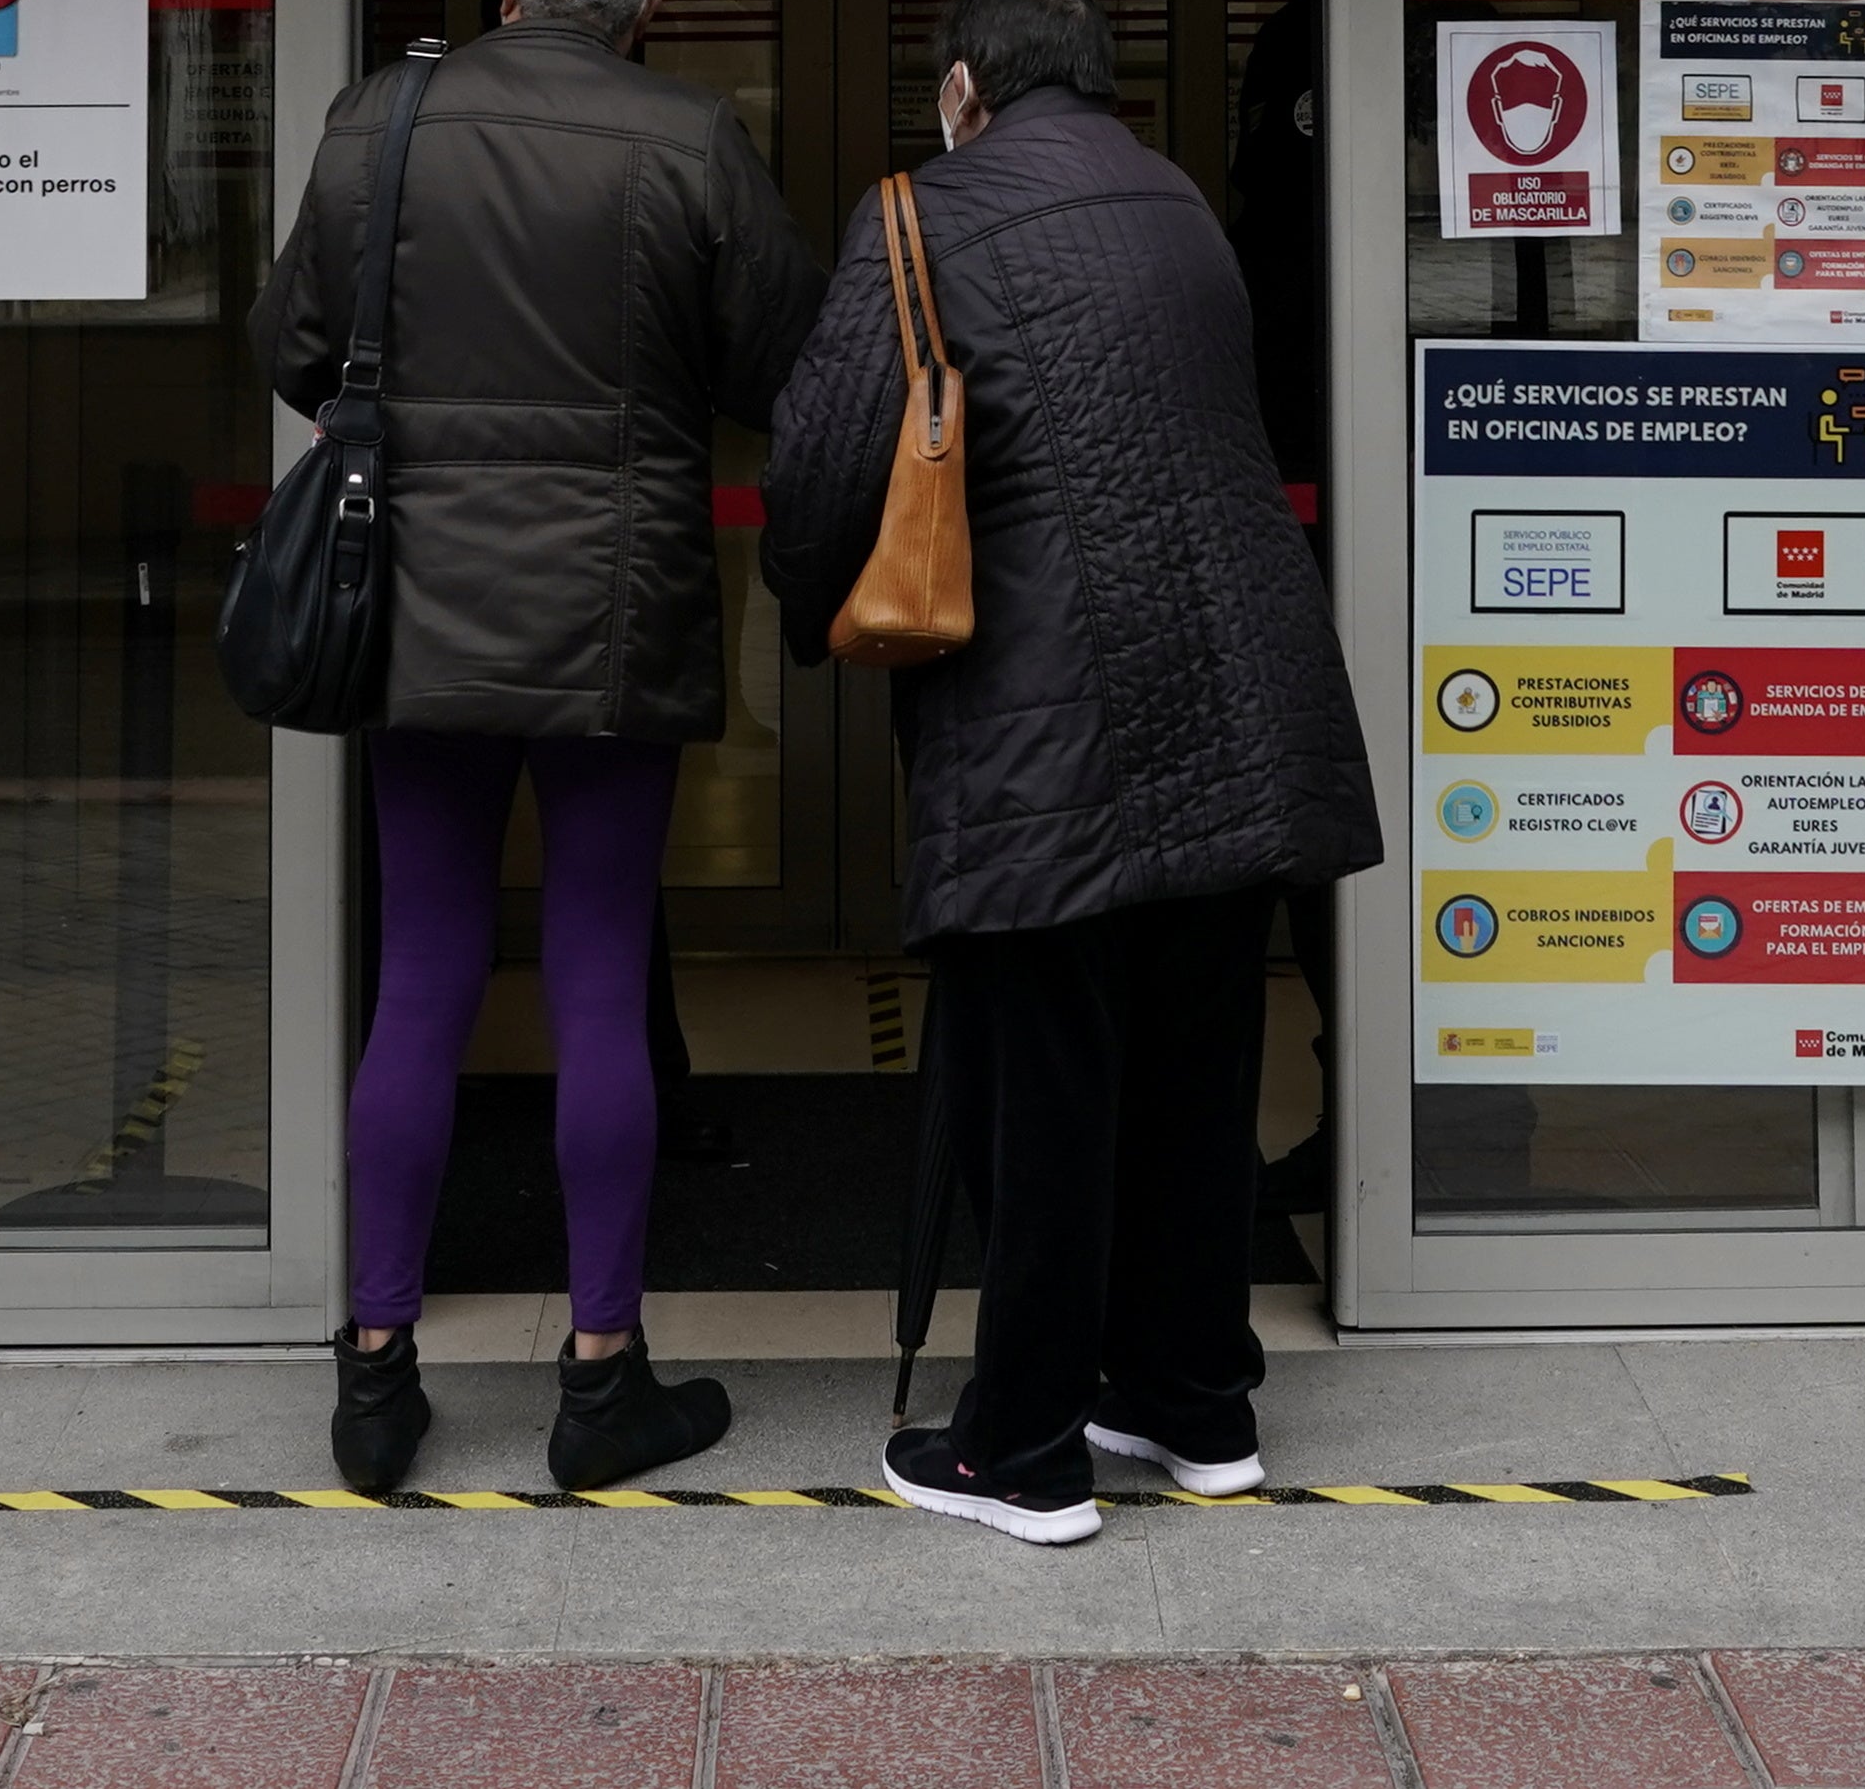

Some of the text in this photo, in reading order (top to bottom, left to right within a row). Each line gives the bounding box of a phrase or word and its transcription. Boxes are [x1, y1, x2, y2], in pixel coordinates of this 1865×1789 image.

[1670, 15, 1825, 29] ¿QUÉ SERVICIOS SE PRESTAN
[1671, 33, 1808, 44] EN OFICINAS DE EMPLEO?
[1695, 83, 1740, 100] SEPE
[19, 151, 38, 168] el
[42, 179, 115, 197] perros
[1518, 177, 1541, 190] USO
[1493, 192, 1566, 205] OBLIGATORIO
[1472, 207, 1587, 221] DE MASCARILLA
[1444, 379, 1786, 409] ¿QUÉ SERVICIOS SE PRESTAN
[1449, 420, 1747, 441] EN OFICINAS DE EMPLEO?
[1503, 531, 1591, 540] SERVICIO PÚBLICO
[1503, 542, 1590, 551] DE EMPLEO ESTATAL
[1504, 568, 1590, 596] SEPE
[1518, 678, 1629, 690] PRESTACIONES
[1767, 685, 1845, 698] SERVICIOS
[1511, 696, 1631, 709] CONTRIBUTIVAS
[1751, 704, 1823, 716] DEMANDA
[1830, 704, 1847, 716] DE
[1532, 715, 1610, 727] SUBSIDIOS
[1742, 772, 1844, 787] ORIENTACIÓN
[1518, 793, 1624, 806] CERTIFICADOS
[1509, 819, 1636, 831] REGISTRO CL@VE
[1793, 820, 1838, 832] EURES
[1749, 839, 1826, 854] GARANTÍA
[1753, 900, 1819, 913] OFERTAS
[1824, 901, 1841, 913] DE
[1507, 910, 1654, 922] COBROS INDEBIDOS
[1538, 935, 1624, 947] SANCIONES
[1767, 942, 1807, 954] PARA
[1812, 942, 1827, 955] EL
[1826, 1045, 1846, 1057] de
